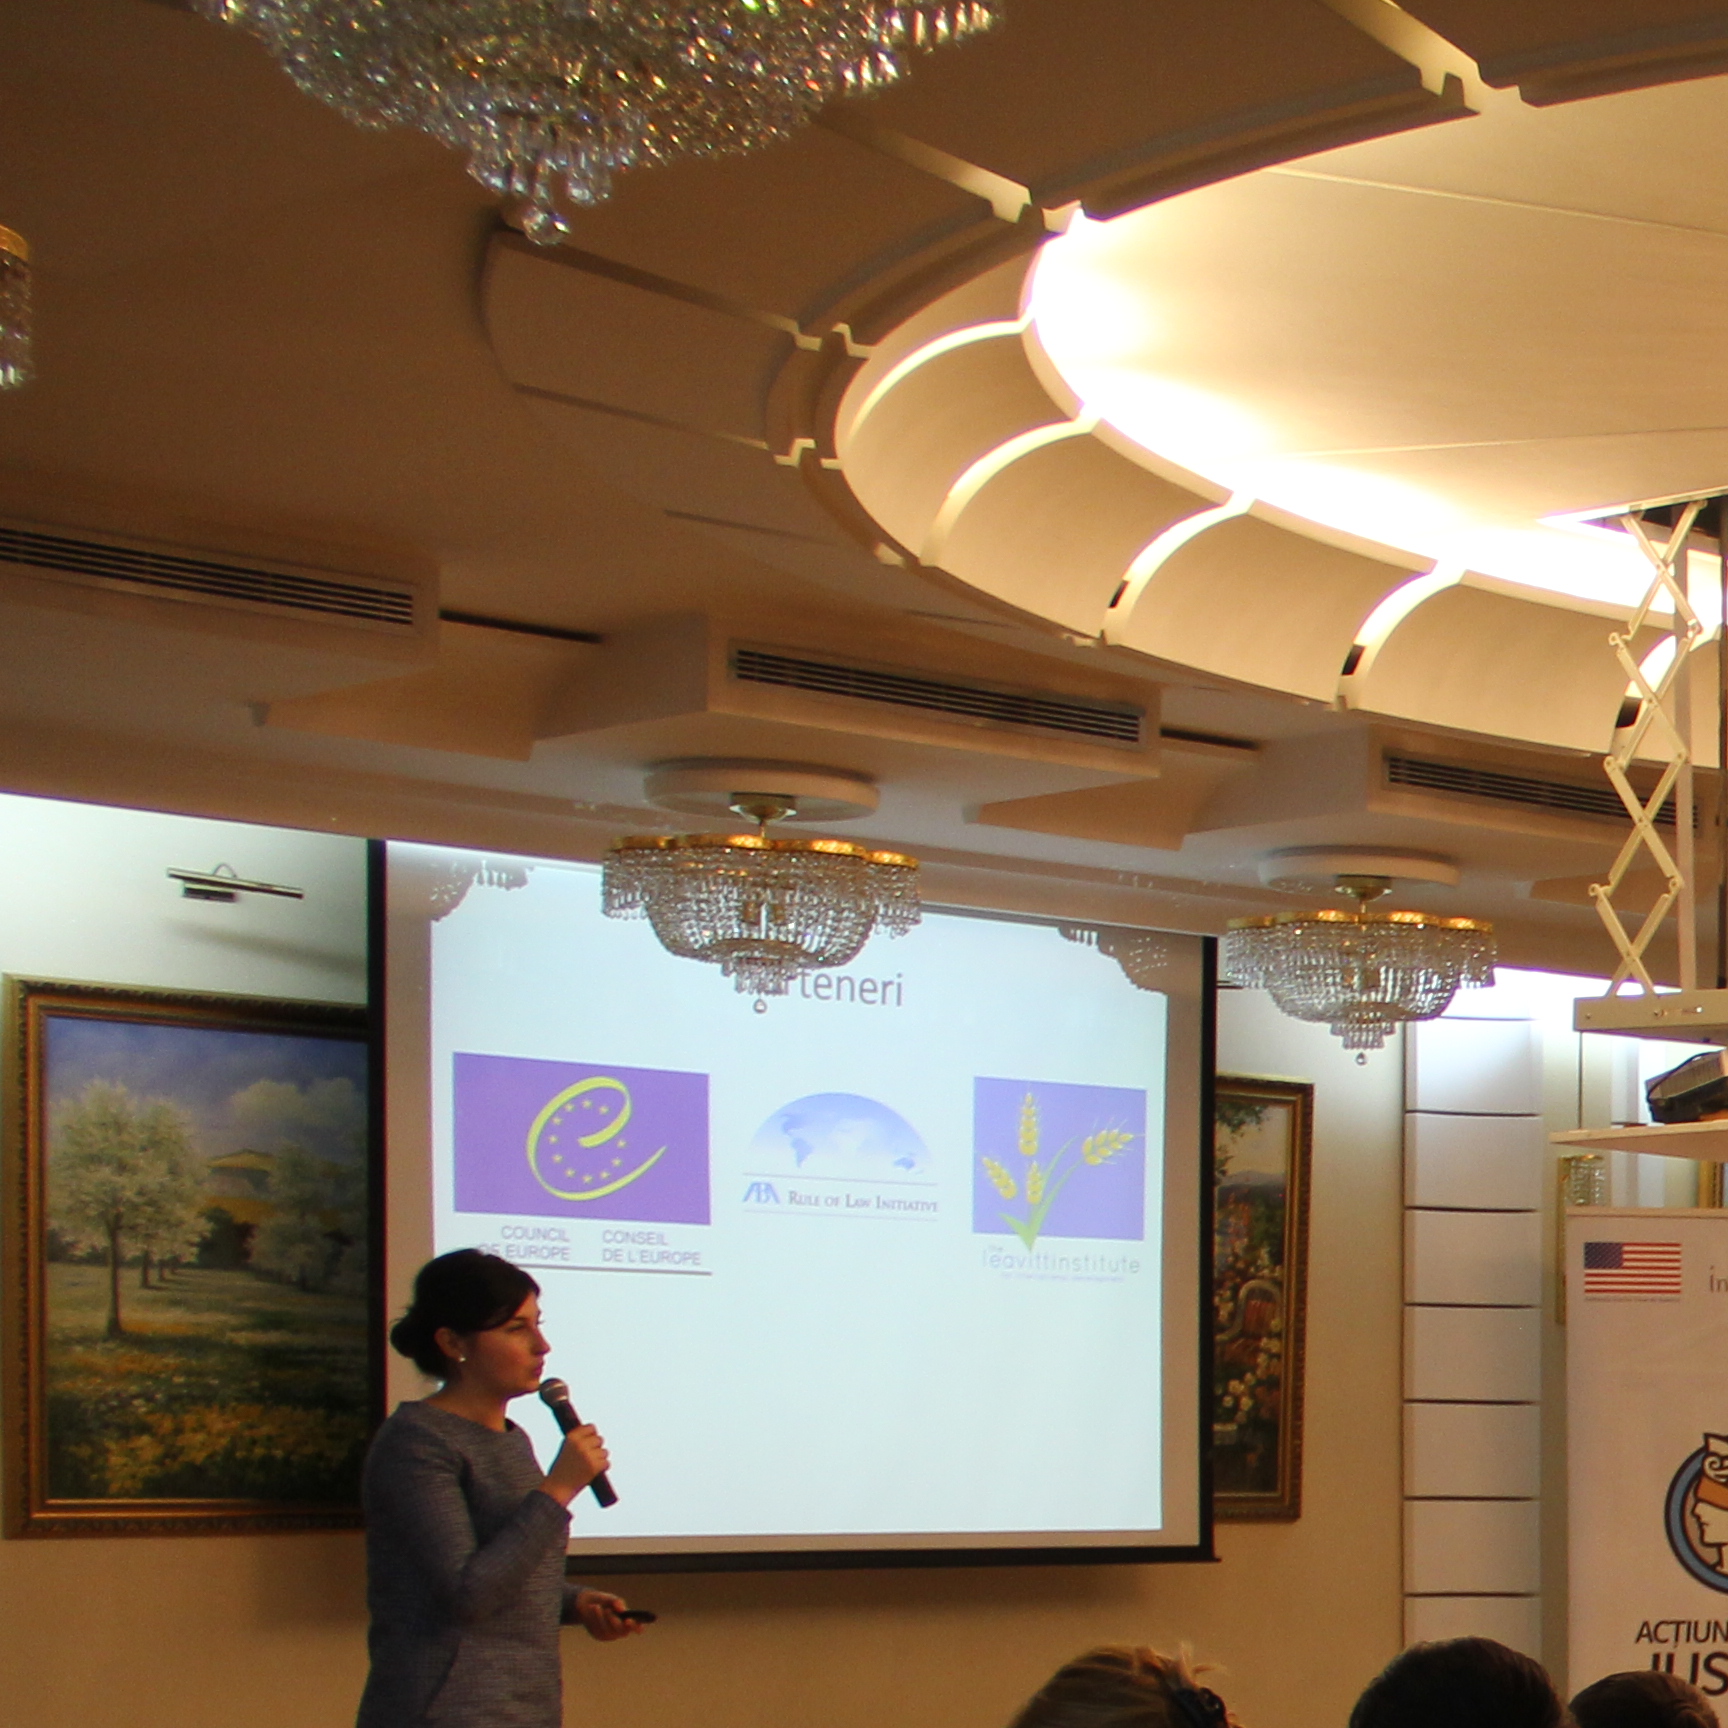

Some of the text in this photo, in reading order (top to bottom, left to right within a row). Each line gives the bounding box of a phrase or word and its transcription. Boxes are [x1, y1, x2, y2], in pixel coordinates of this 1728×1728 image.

[501, 1225, 571, 1243] COUNCIL
[602, 1229, 670, 1246] CONSEIL
[505, 1244, 571, 1262] EUROPE
[602, 1248, 702, 1266] DE L'EUROPE
